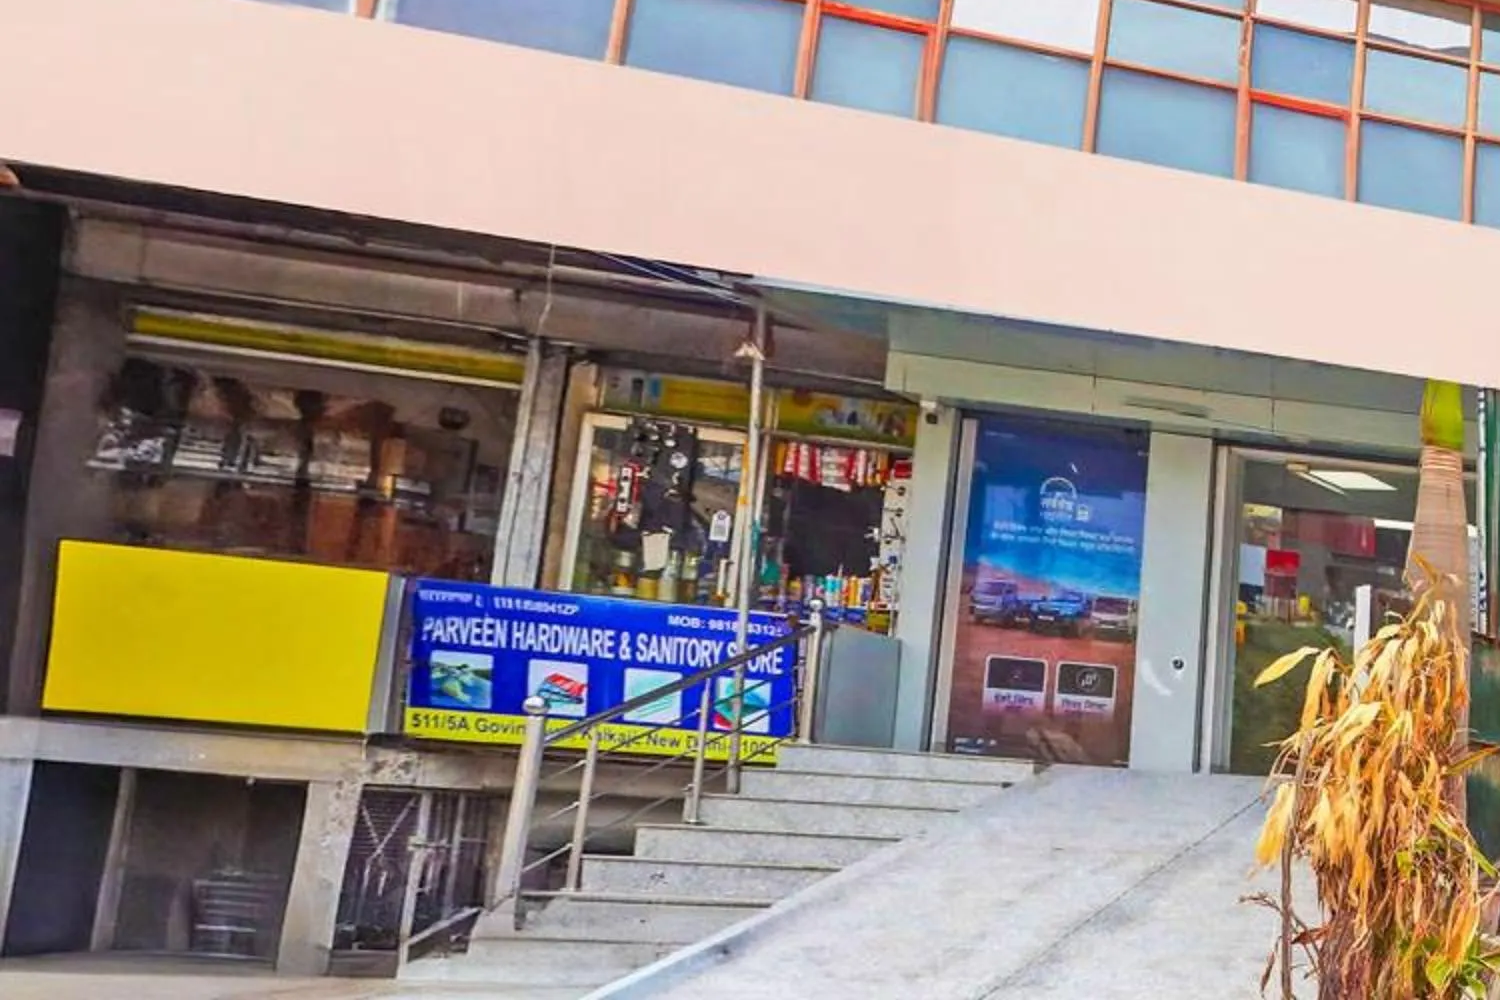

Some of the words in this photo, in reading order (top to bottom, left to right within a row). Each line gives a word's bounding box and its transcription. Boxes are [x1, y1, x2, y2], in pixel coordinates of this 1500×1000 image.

[421, 616, 508, 649] PARVEEN
[511, 620, 616, 660] HARDWARE
[618, 630, 632, 661] &
[635, 632, 725, 669] SANITORY
[411, 712, 469, 732] 511/5A
